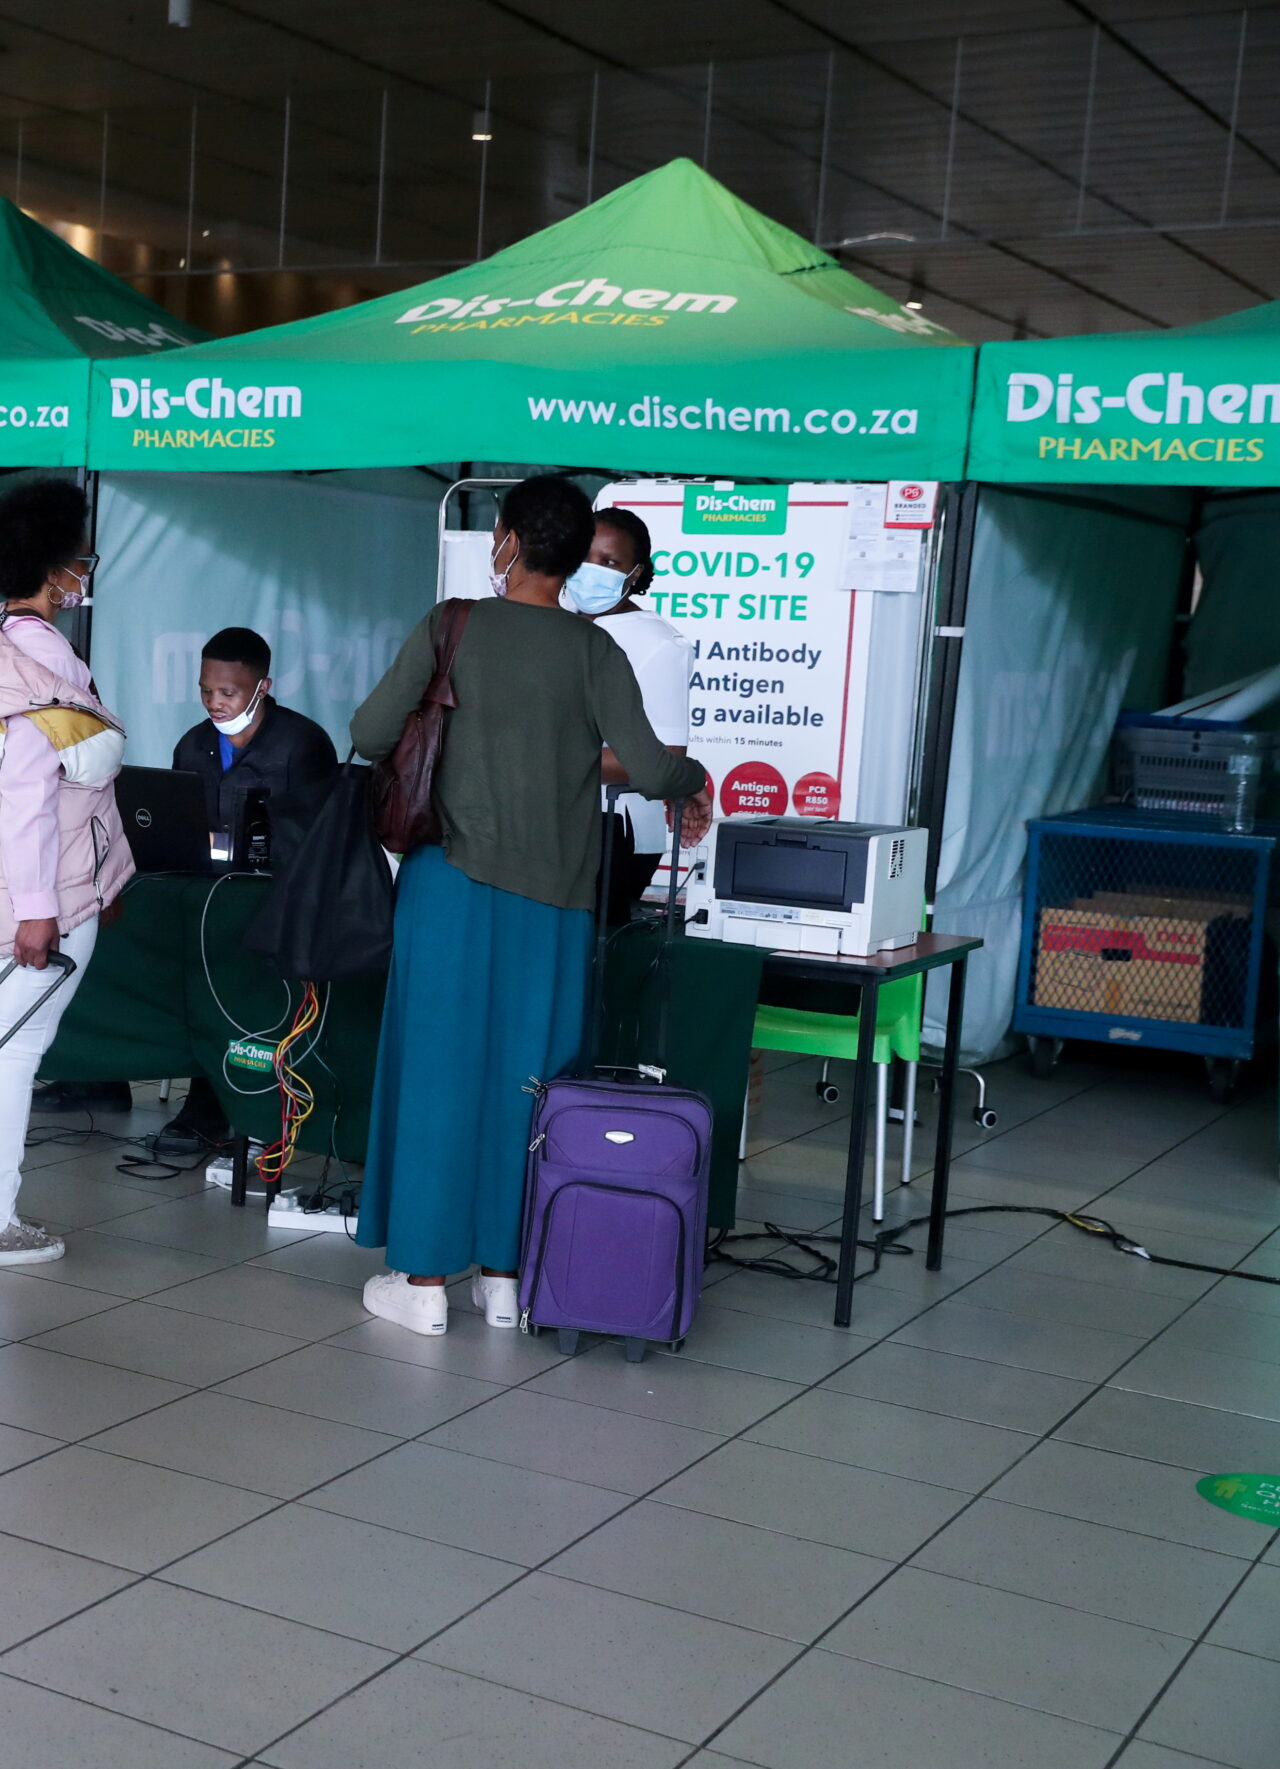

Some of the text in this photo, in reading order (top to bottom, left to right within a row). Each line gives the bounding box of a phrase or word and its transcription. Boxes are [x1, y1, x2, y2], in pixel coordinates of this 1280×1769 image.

[394, 278, 738, 324] Dis-Chem
[411, 311, 670, 334] PHARMACIES
[110, 378, 302, 419] Dis-Chem
[528, 395, 919, 435] www.dischem.co.za
[132, 428, 275, 448] PHARMACIES
[1038, 436, 1264, 462] PHARMACIES
[696, 495, 776, 511] Dis-Chem
[702, 513, 767, 522] PHARMACIES
[651, 550, 815, 578] COVID-19
[650, 592, 808, 621] TEST SITE
[707, 641, 822, 670] Antibody
[689, 671, 784, 698] Antigen
[714, 704, 824, 727] available
[689, 735, 783, 747] ults within 15 minutes
[731, 780, 778, 795] Antigen
[808, 785, 827, 794] PCR
[738, 796, 770, 807] R250
[805, 796, 828, 805] R850
[230, 1041, 273, 1061] Dis-Chem
